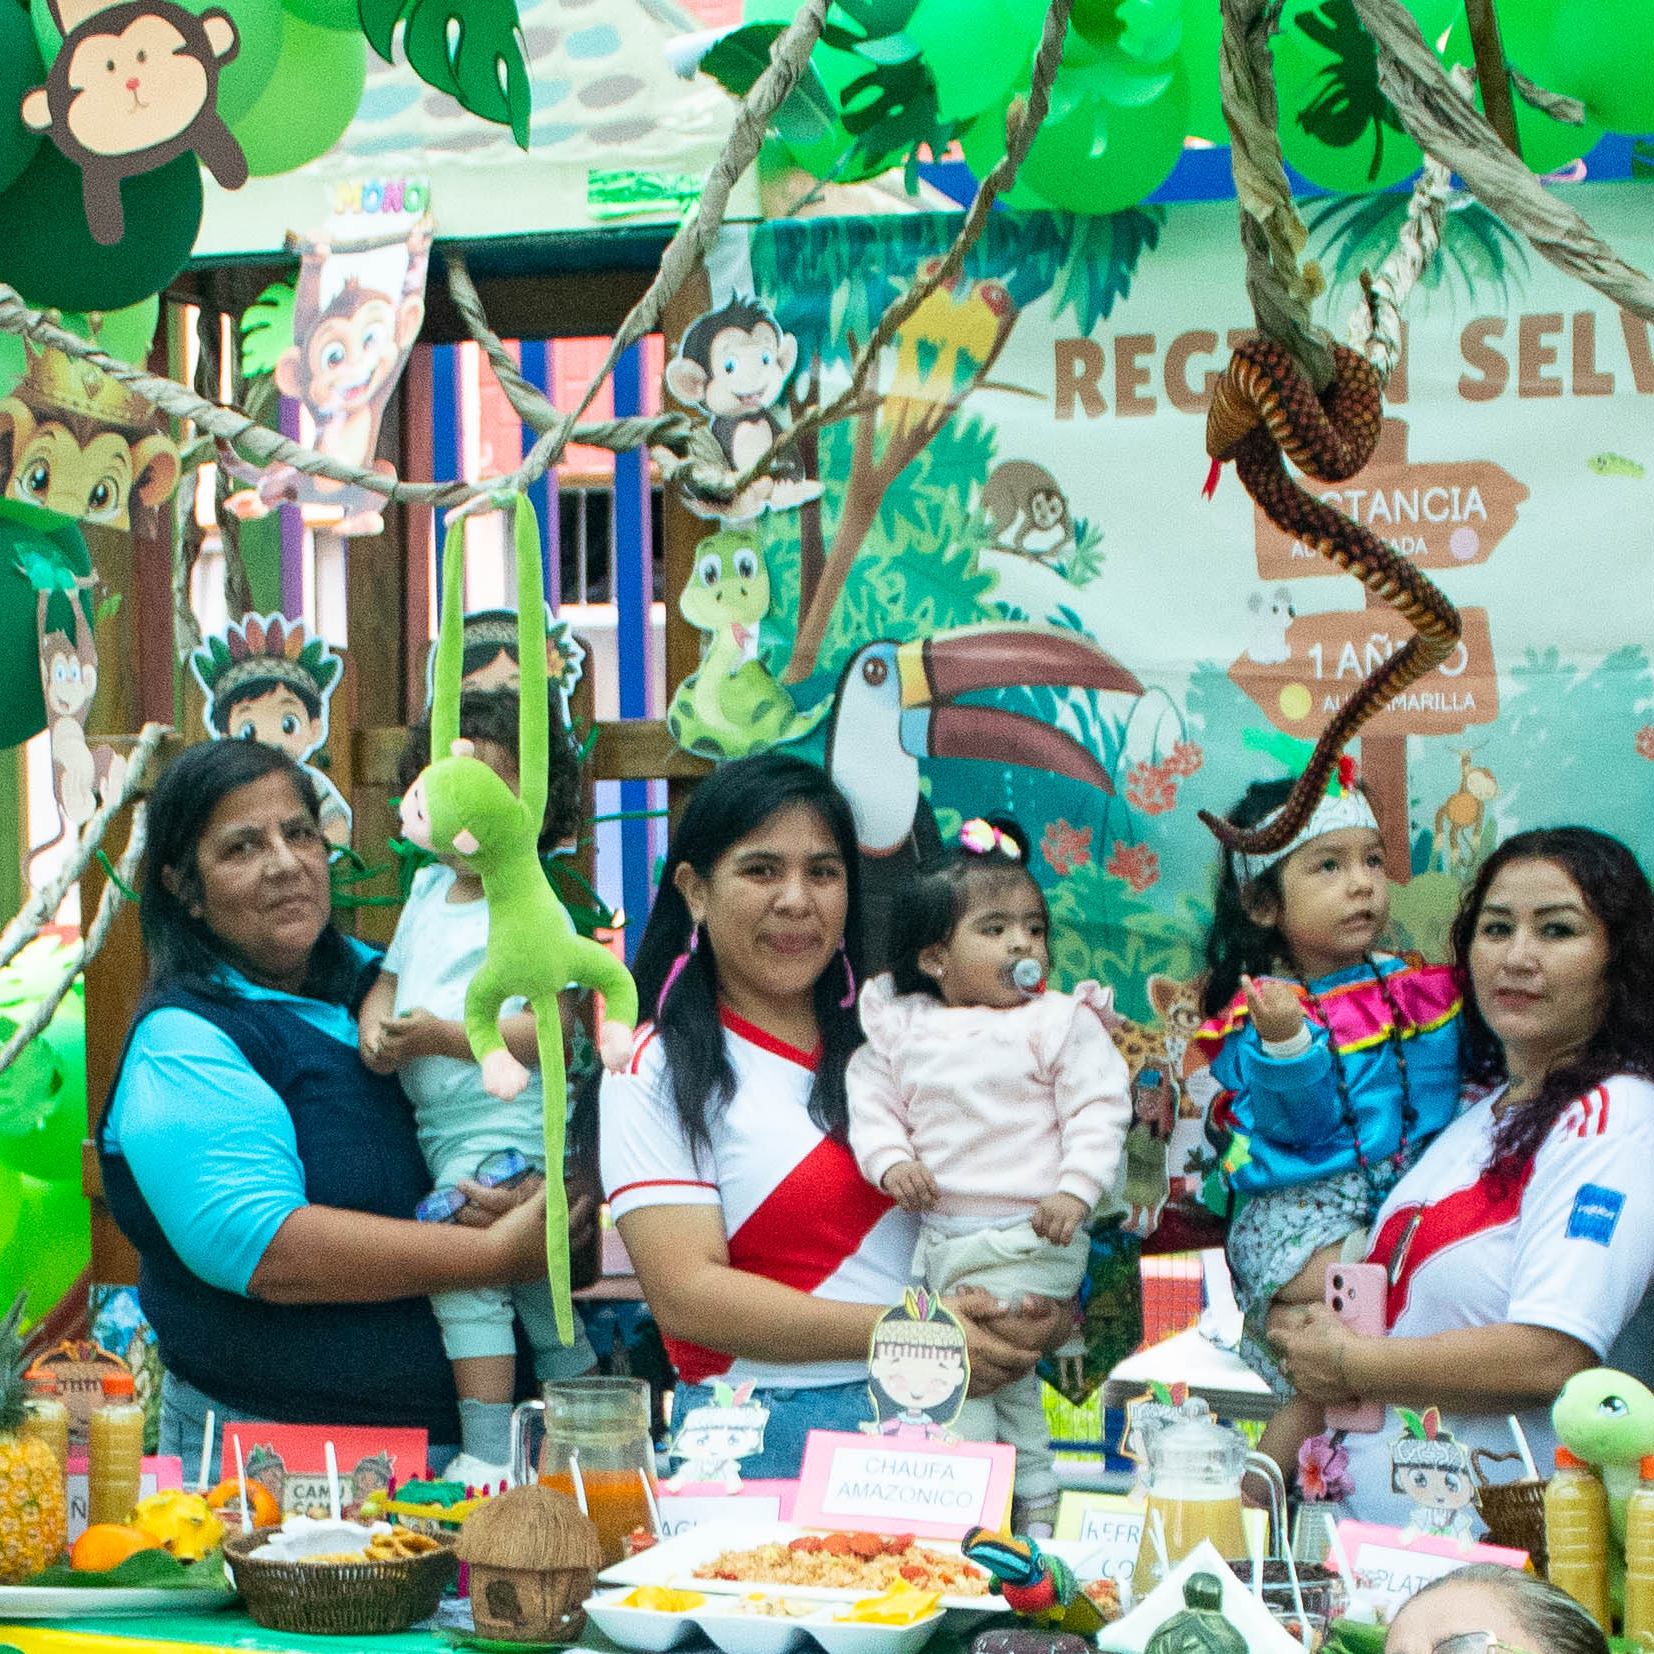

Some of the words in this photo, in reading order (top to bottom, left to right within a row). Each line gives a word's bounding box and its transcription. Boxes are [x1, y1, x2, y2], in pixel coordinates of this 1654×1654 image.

[335, 178, 429, 215] MONO
[1308, 643, 1323, 680] 1
[865, 1456, 955, 1480] CHAUFA
[837, 1481, 974, 1508] AMAZONICO
